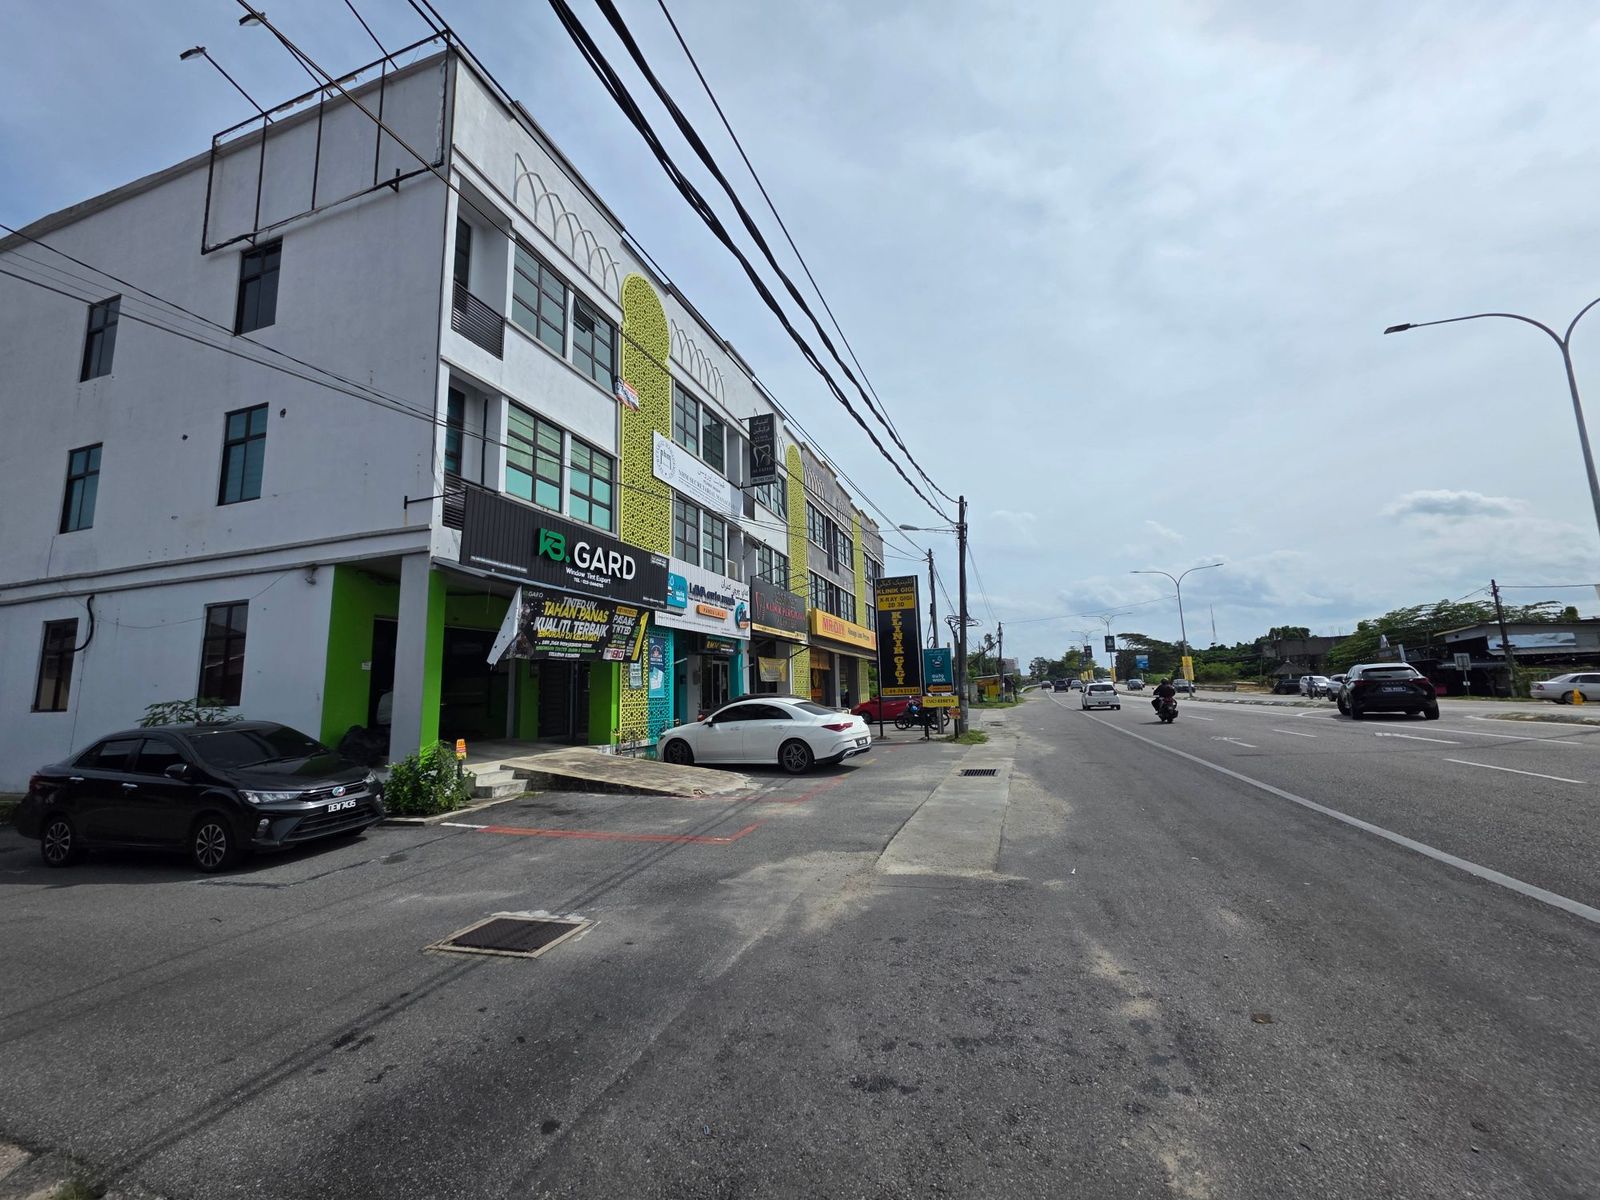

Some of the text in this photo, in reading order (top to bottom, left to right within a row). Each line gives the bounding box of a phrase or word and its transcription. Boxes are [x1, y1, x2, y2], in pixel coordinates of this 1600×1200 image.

[574, 541, 636, 580] GARD
[566, 568, 586, 578] Window
[544, 601, 578, 618] TAHAN
[578, 607, 609, 623] PANAS
[533, 617, 609, 637] KUALITI TERBAIK
[891, 611, 905, 655] KLINIK
